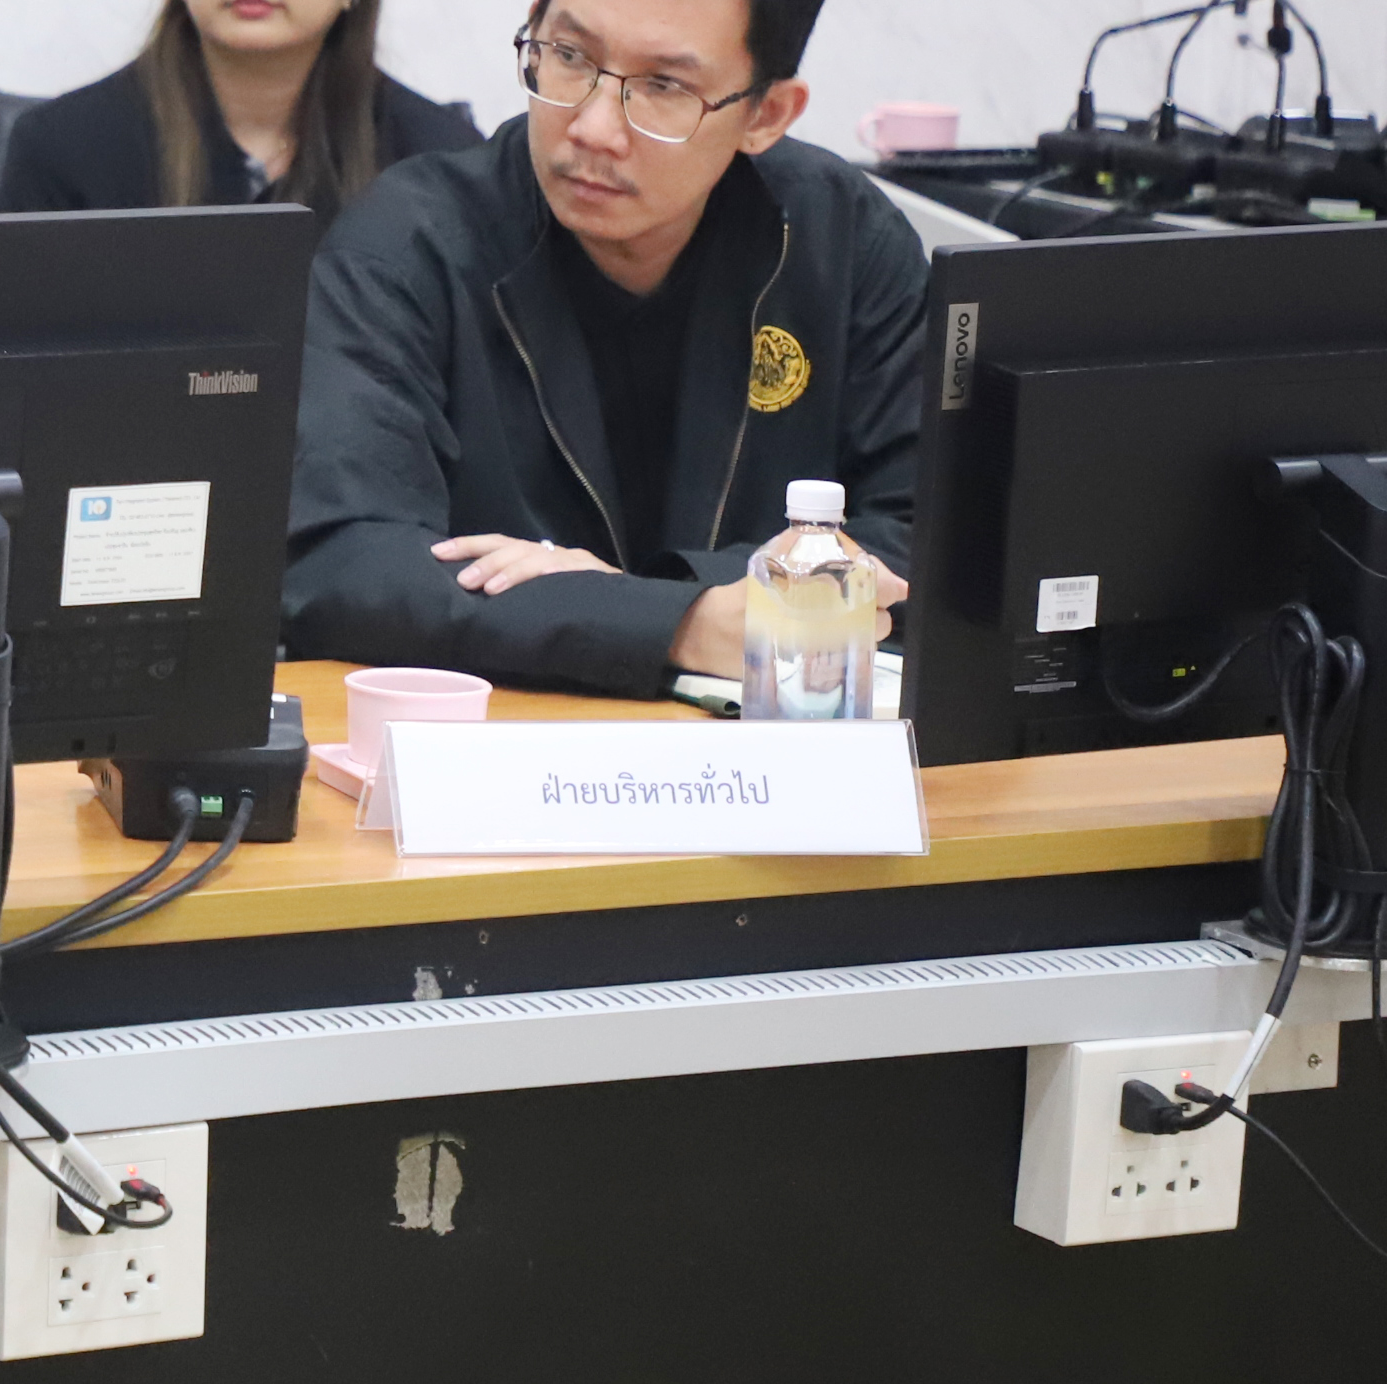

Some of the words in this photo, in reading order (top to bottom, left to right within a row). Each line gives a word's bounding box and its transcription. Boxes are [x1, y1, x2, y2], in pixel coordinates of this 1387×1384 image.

[949, 312, 971, 400] Lenovo
[188, 369, 259, 396] ThinkVision
[542, 763, 770, 805] ฝ่ายบริหารทั่วไป
